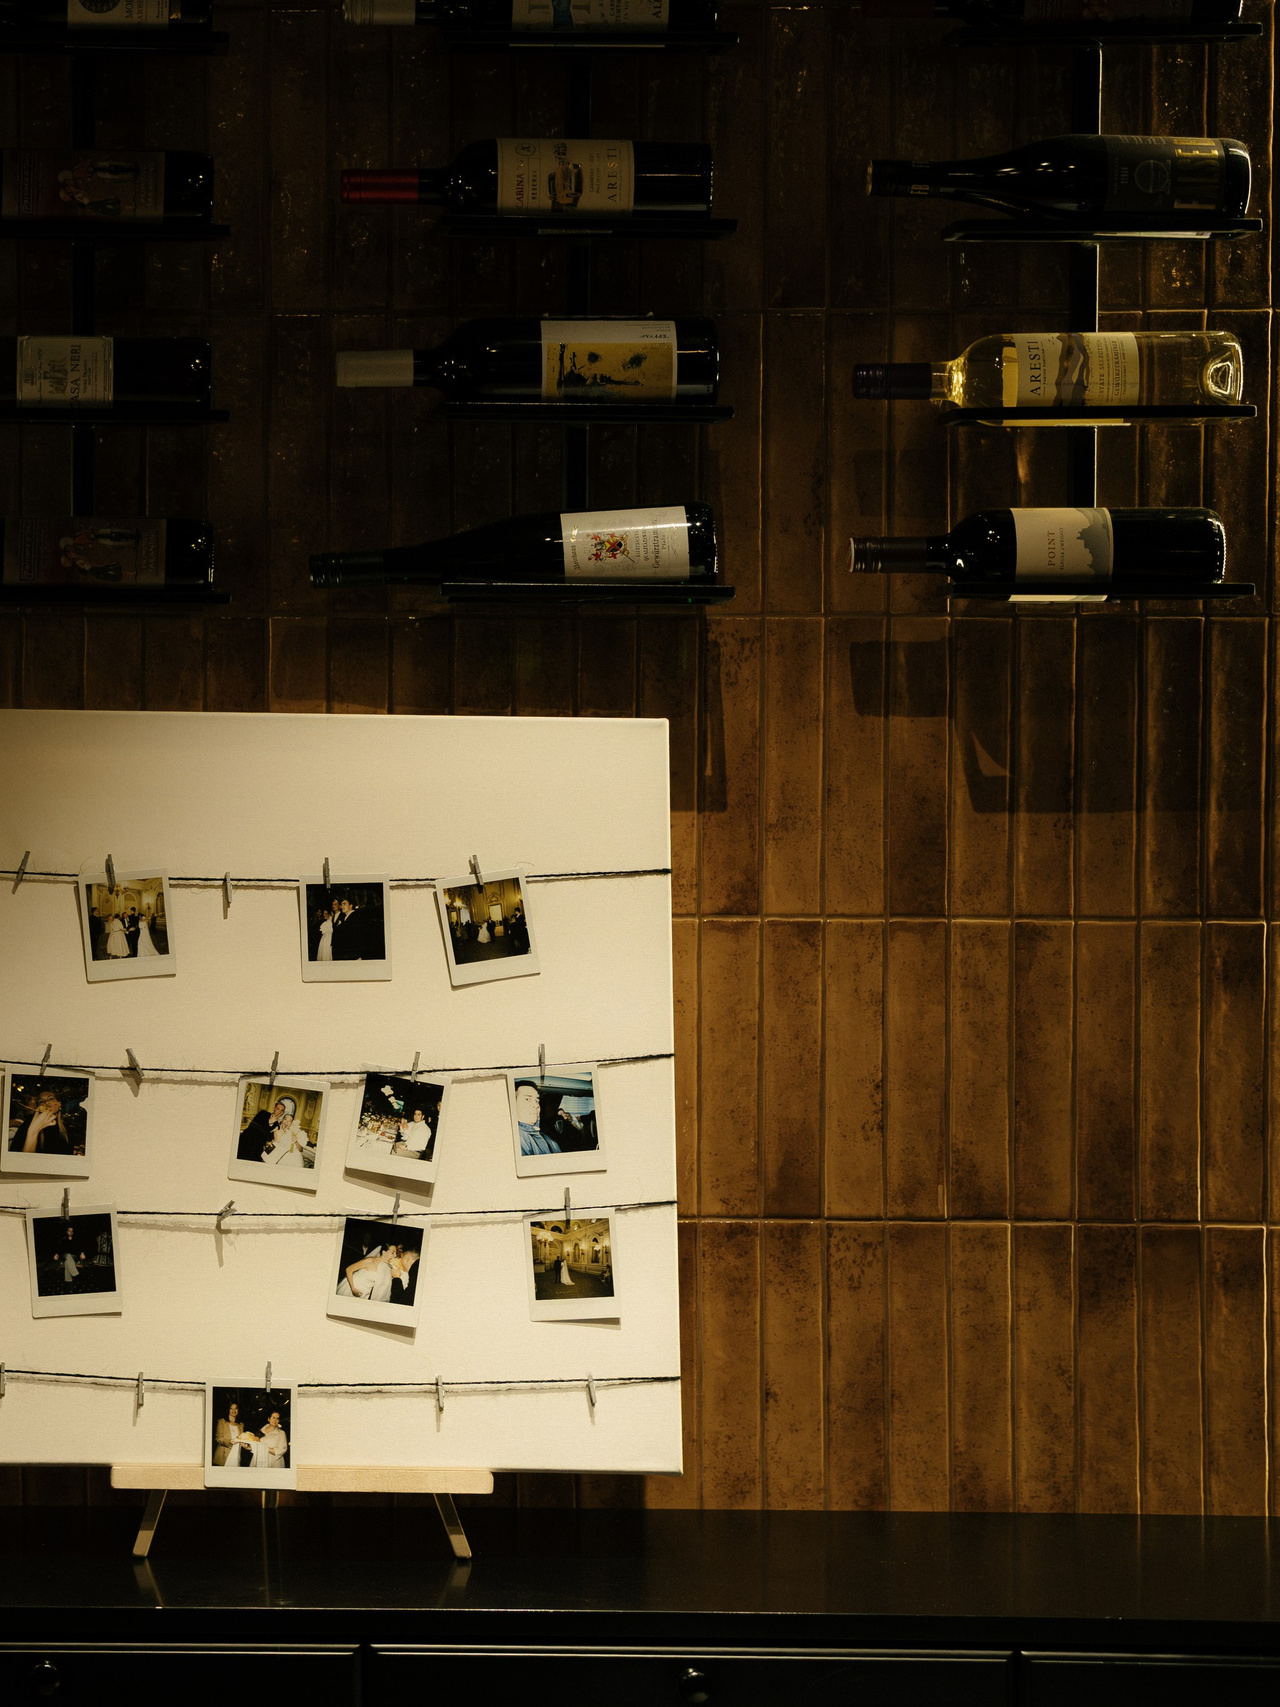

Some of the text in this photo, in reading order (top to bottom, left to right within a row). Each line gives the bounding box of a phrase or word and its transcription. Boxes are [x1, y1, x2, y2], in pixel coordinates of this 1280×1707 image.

[515, 173, 524, 208] CABINA
[607, 147, 618, 202] ARESTI
[70, 344, 81, 373] NERI
[1026, 340, 1041, 397] ARESTI
[1047, 530, 1056, 567] POINT
